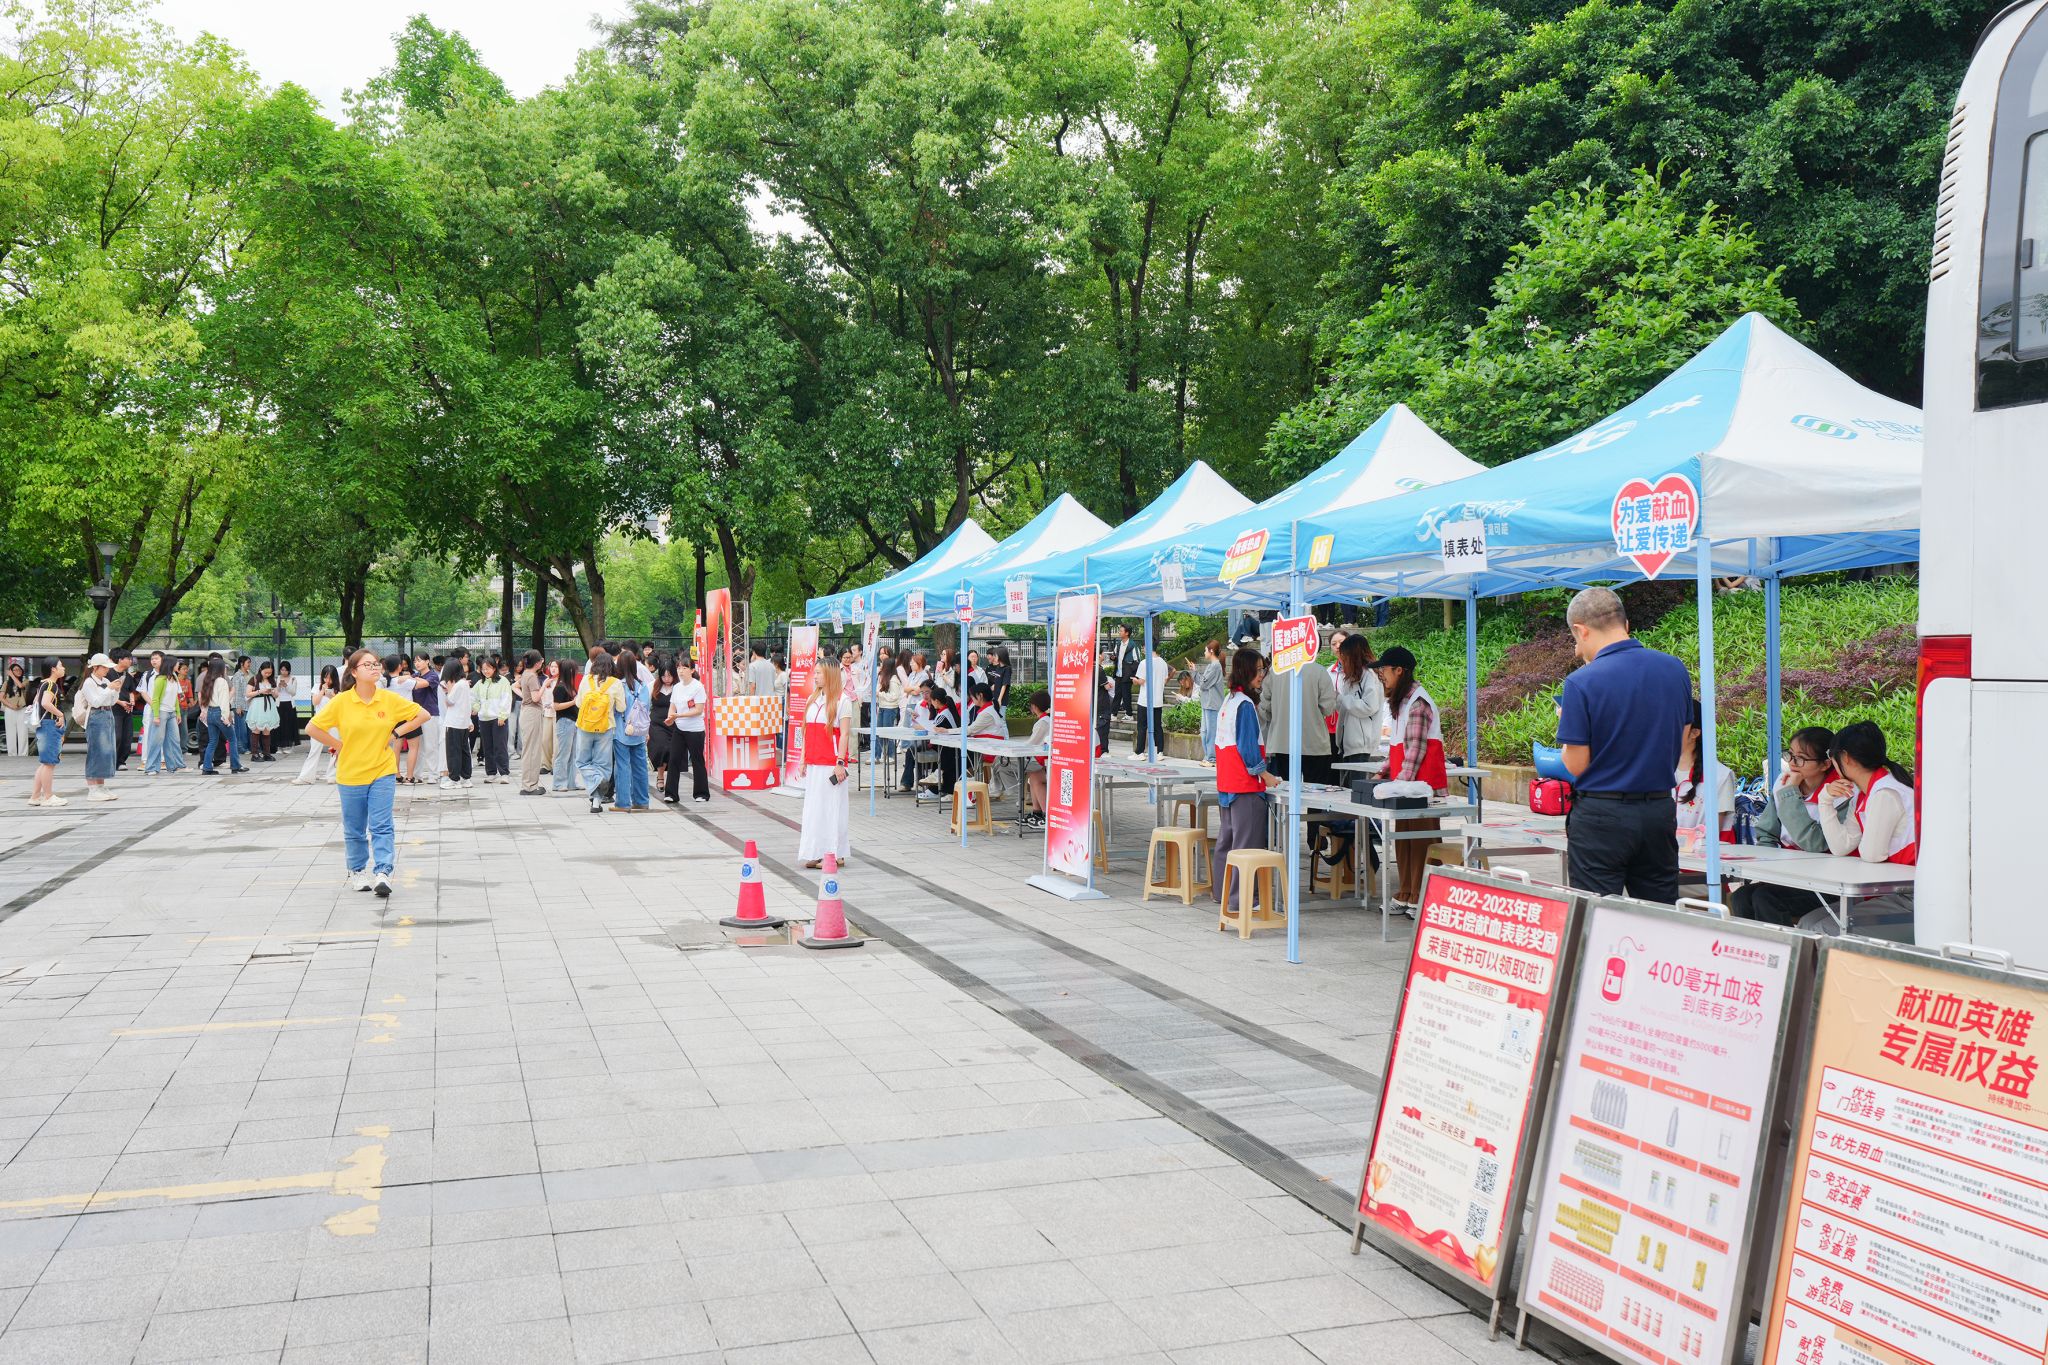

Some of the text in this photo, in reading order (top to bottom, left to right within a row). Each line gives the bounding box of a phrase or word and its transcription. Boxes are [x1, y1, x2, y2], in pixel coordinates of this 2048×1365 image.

[1619, 494, 1688, 525] 为爱献血
[1314, 540, 1328, 565] Hi
[1444, 536, 1483, 558] 填表处
[1618, 525, 1688, 552] 让爱传递
[732, 737, 750, 769] Hi
[1447, 885, 1543, 925] 2022-2023年度
[1425, 902, 1558, 955] 全国无偿献血表彰奖励
[1647, 959, 1764, 1007] 400毫升血液
[1896, 984, 2034, 1047] 献血英雄
[1879, 1022, 2039, 1100] 专属权益
[1836, 1095, 1886, 1122] 门诊挂号
[1851, 1085, 1877, 1104] 优先
[1829, 1132, 1884, 1164] 优先用血
[1823, 1170, 1872, 1199] 免交血液
[1825, 1188, 1864, 1212] 成本费
[1819, 1222, 1859, 1246] 免门诊
[1818, 1238, 1857, 1262] 诊查费
[1806, 1283, 1854, 1316] 游览公园
[1819, 1276, 1844, 1297] 免费
